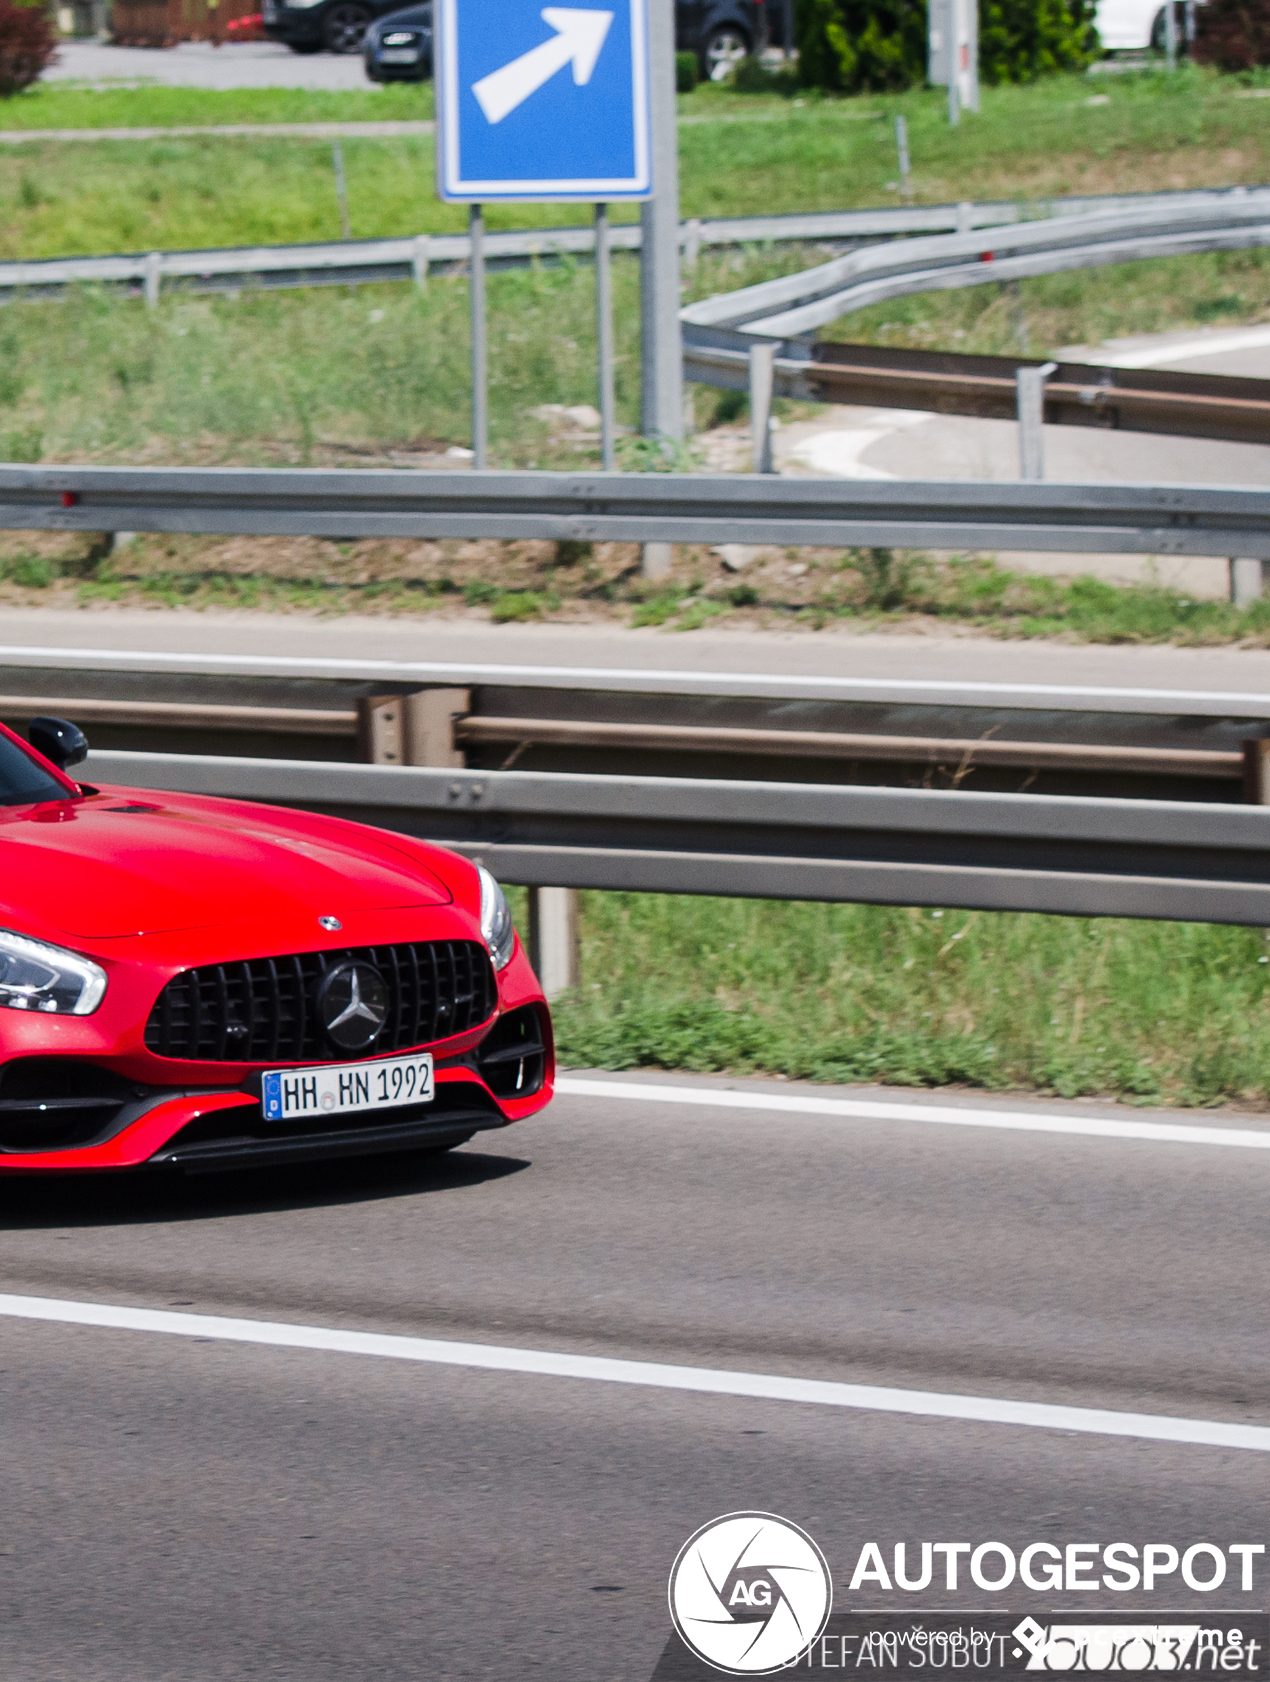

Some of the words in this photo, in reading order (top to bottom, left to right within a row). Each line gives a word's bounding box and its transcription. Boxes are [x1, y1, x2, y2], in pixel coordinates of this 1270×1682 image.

[284, 1076, 318, 1111] HH
[339, 1071, 369, 1105] HN
[377, 1063, 430, 1101] 1992
